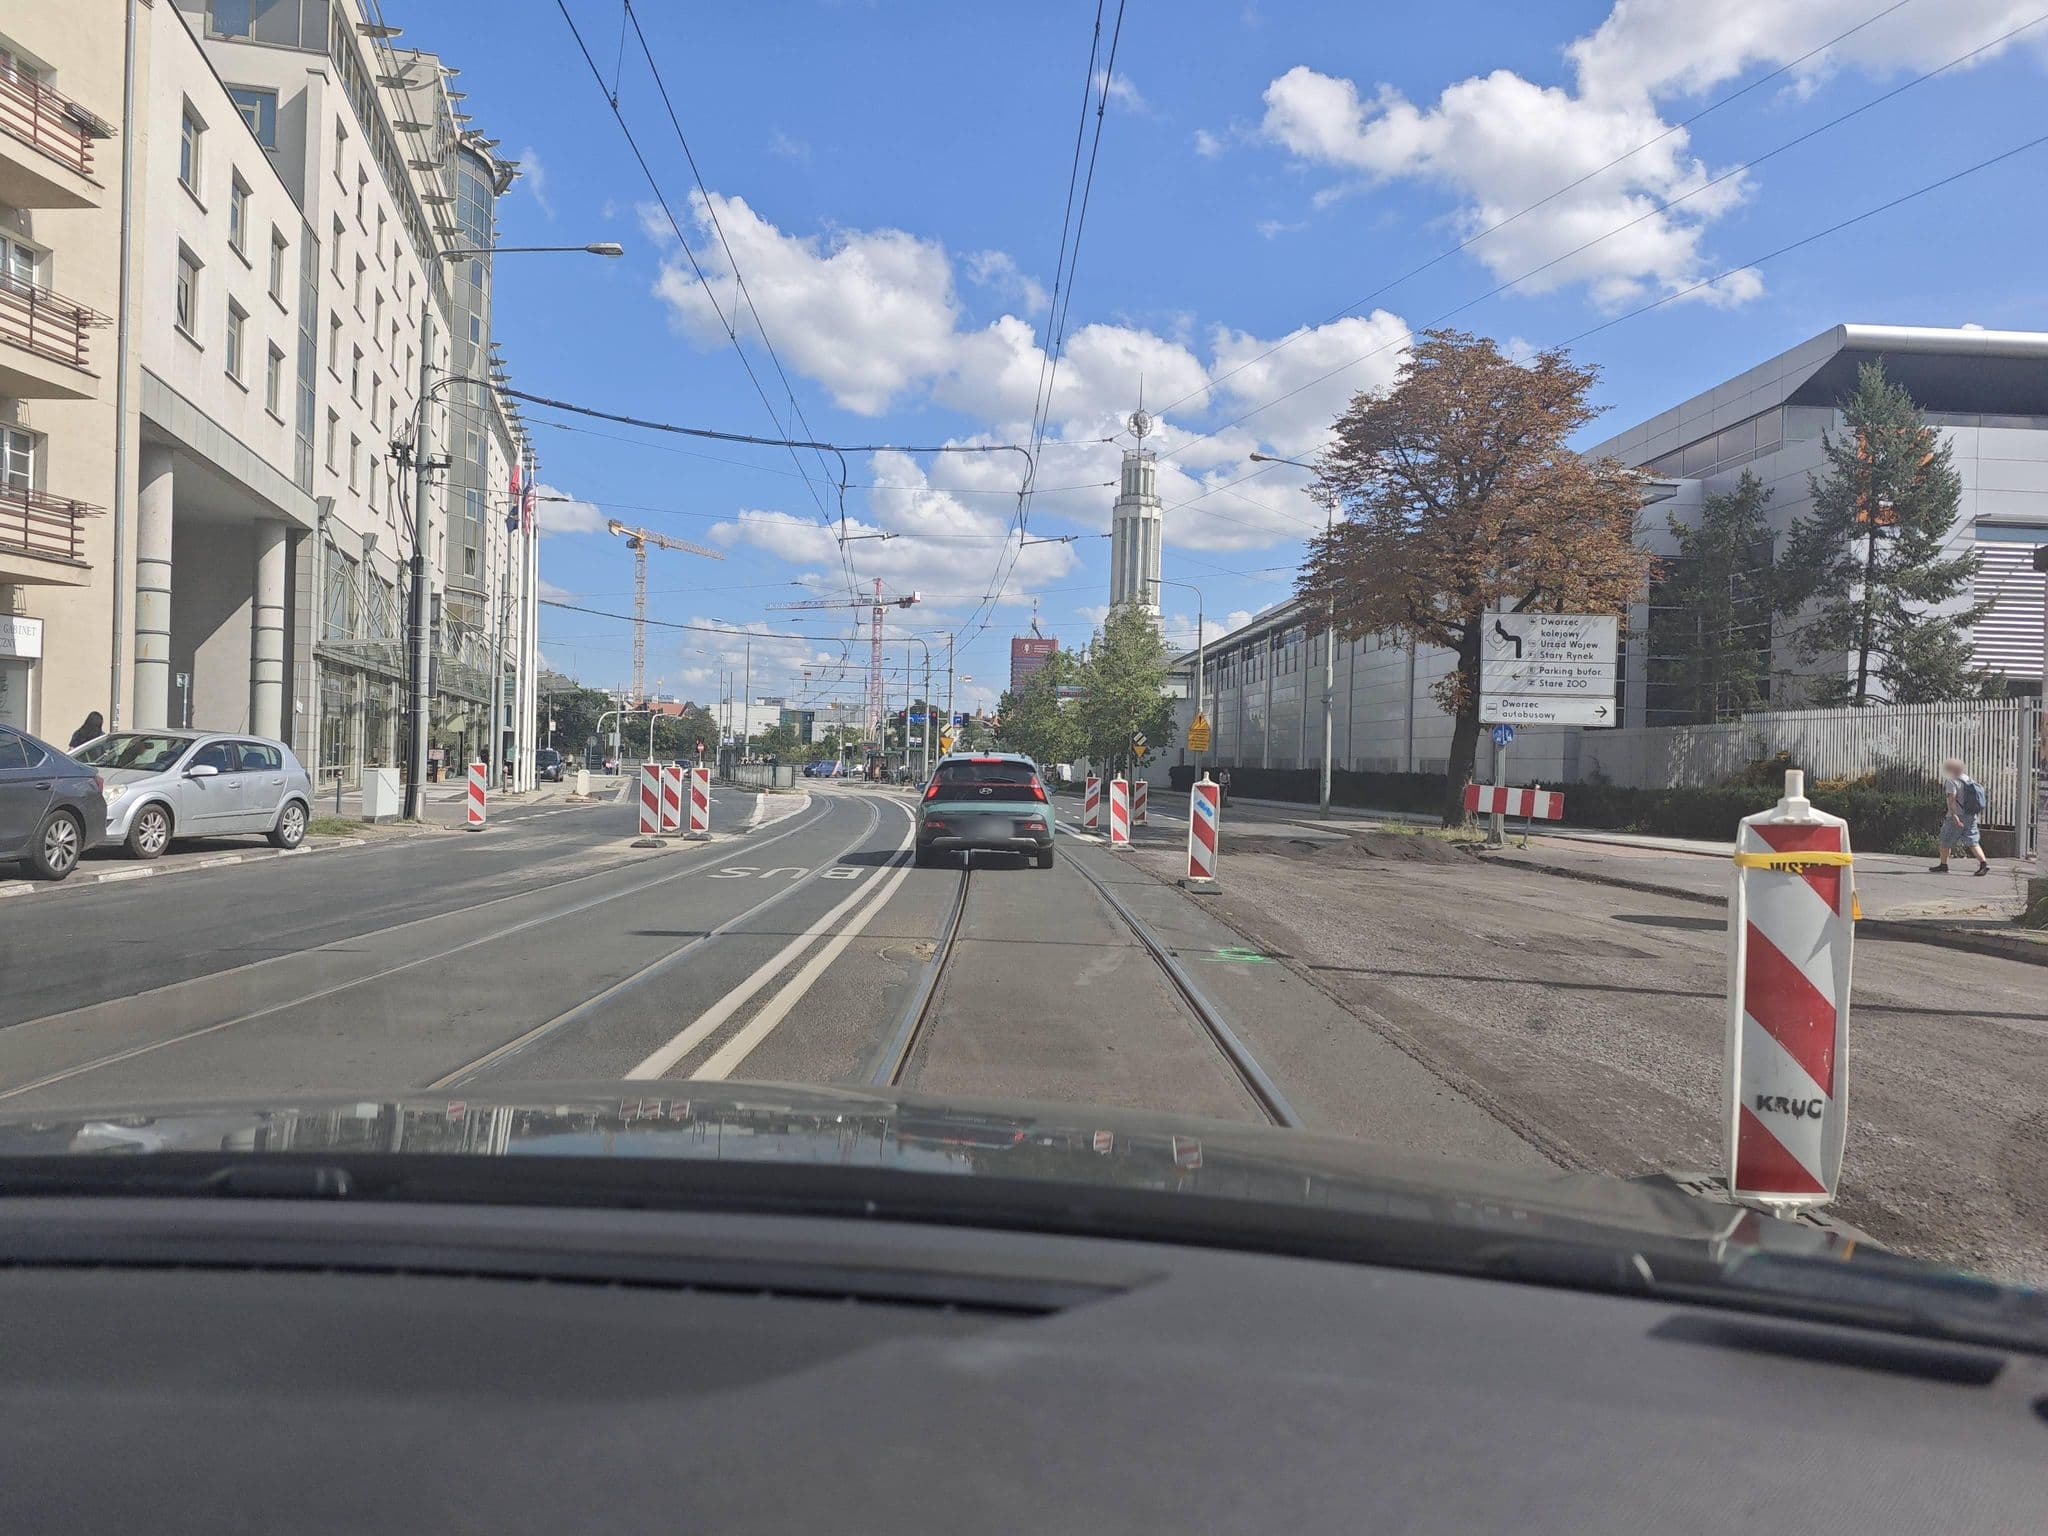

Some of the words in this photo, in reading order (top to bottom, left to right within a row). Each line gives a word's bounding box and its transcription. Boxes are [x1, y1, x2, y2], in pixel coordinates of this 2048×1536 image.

[1541, 617, 1579, 626] Dworzec
[3, 623, 37, 637] GABINET
[1541, 629, 1580, 639] kolejowy
[1540, 640, 1566, 649] Urząd
[1569, 640, 1601, 650] Wojew.
[1539, 650, 1563, 660] Stary
[1566, 651, 1594, 661] Rynek
[1539, 666, 1573, 676] Parking
[1539, 679, 1563, 688] Stare
[1566, 680, 1588, 688] ZOO
[1502, 699, 1539, 708] Dworzec
[1502, 711, 1556, 720] autobusowy
[707, 866, 865, 880] BUS
[1756, 1094, 1823, 1119] KRUG
